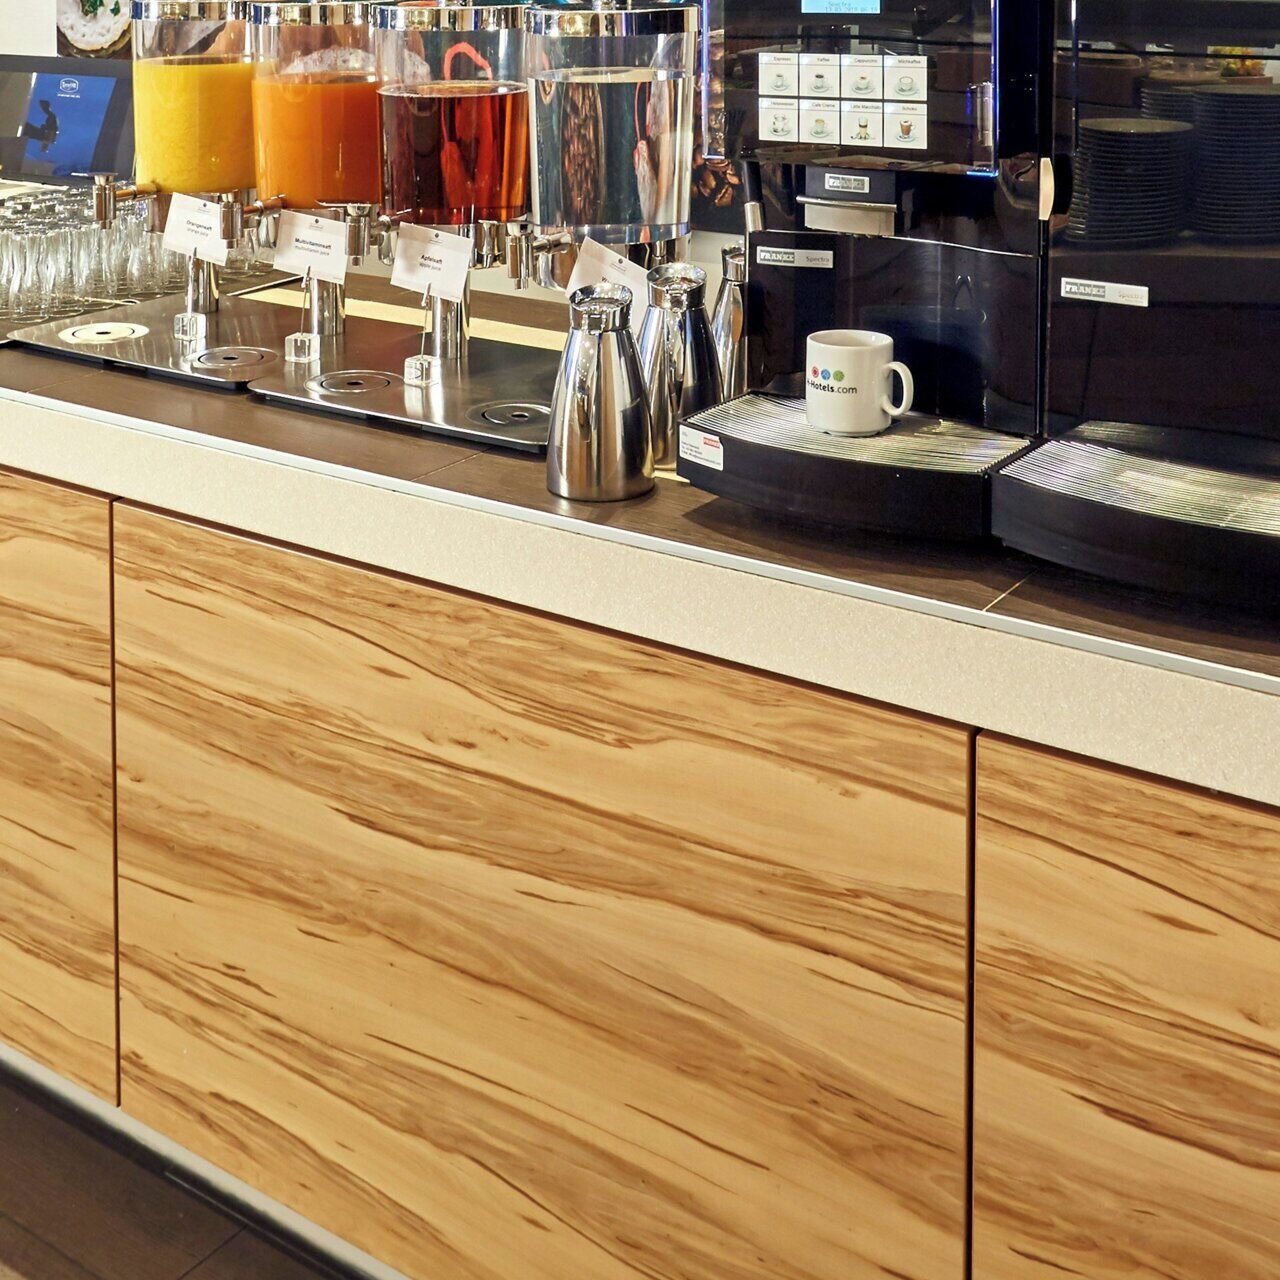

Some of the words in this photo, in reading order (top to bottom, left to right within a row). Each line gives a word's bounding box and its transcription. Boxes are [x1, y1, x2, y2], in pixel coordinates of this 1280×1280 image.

[760, 251, 795, 262] FRANKE
[806, 255, 830, 263] Spectra
[1065, 284, 1106, 296] FRANKE
